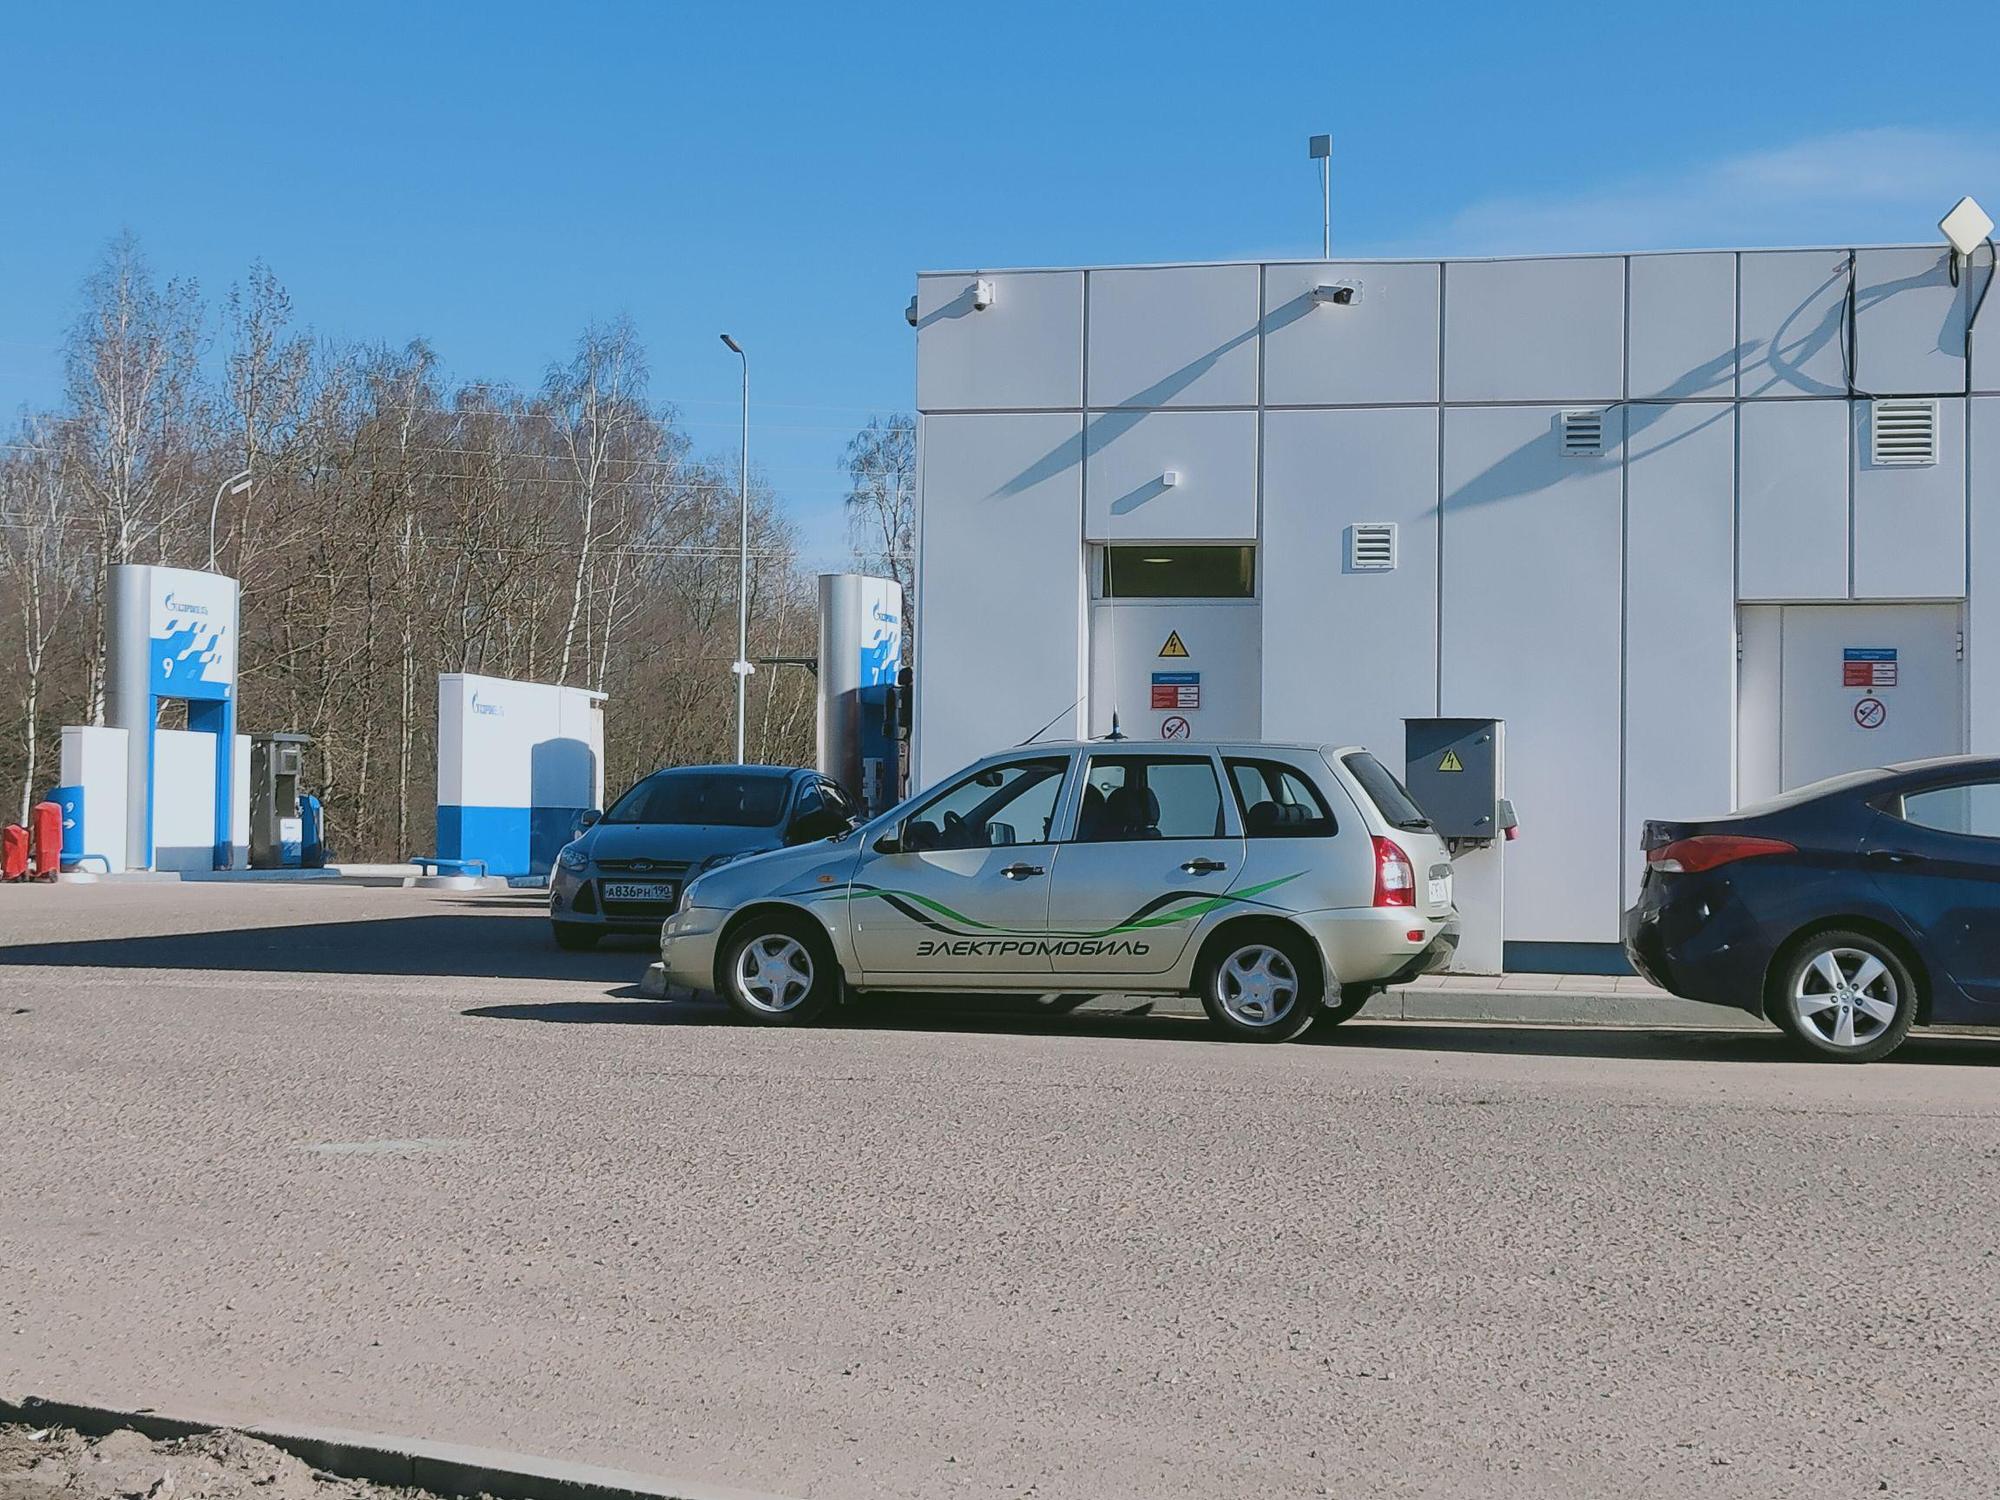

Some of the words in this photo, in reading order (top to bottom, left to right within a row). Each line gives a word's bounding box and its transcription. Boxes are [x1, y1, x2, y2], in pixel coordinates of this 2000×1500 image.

[163, 658, 174, 679] 9
[872, 667, 880, 687] 7
[66, 802, 75, 813] 9
[917, 941, 1150, 956] ЭЛЕКТРОМОБИЛЬ
